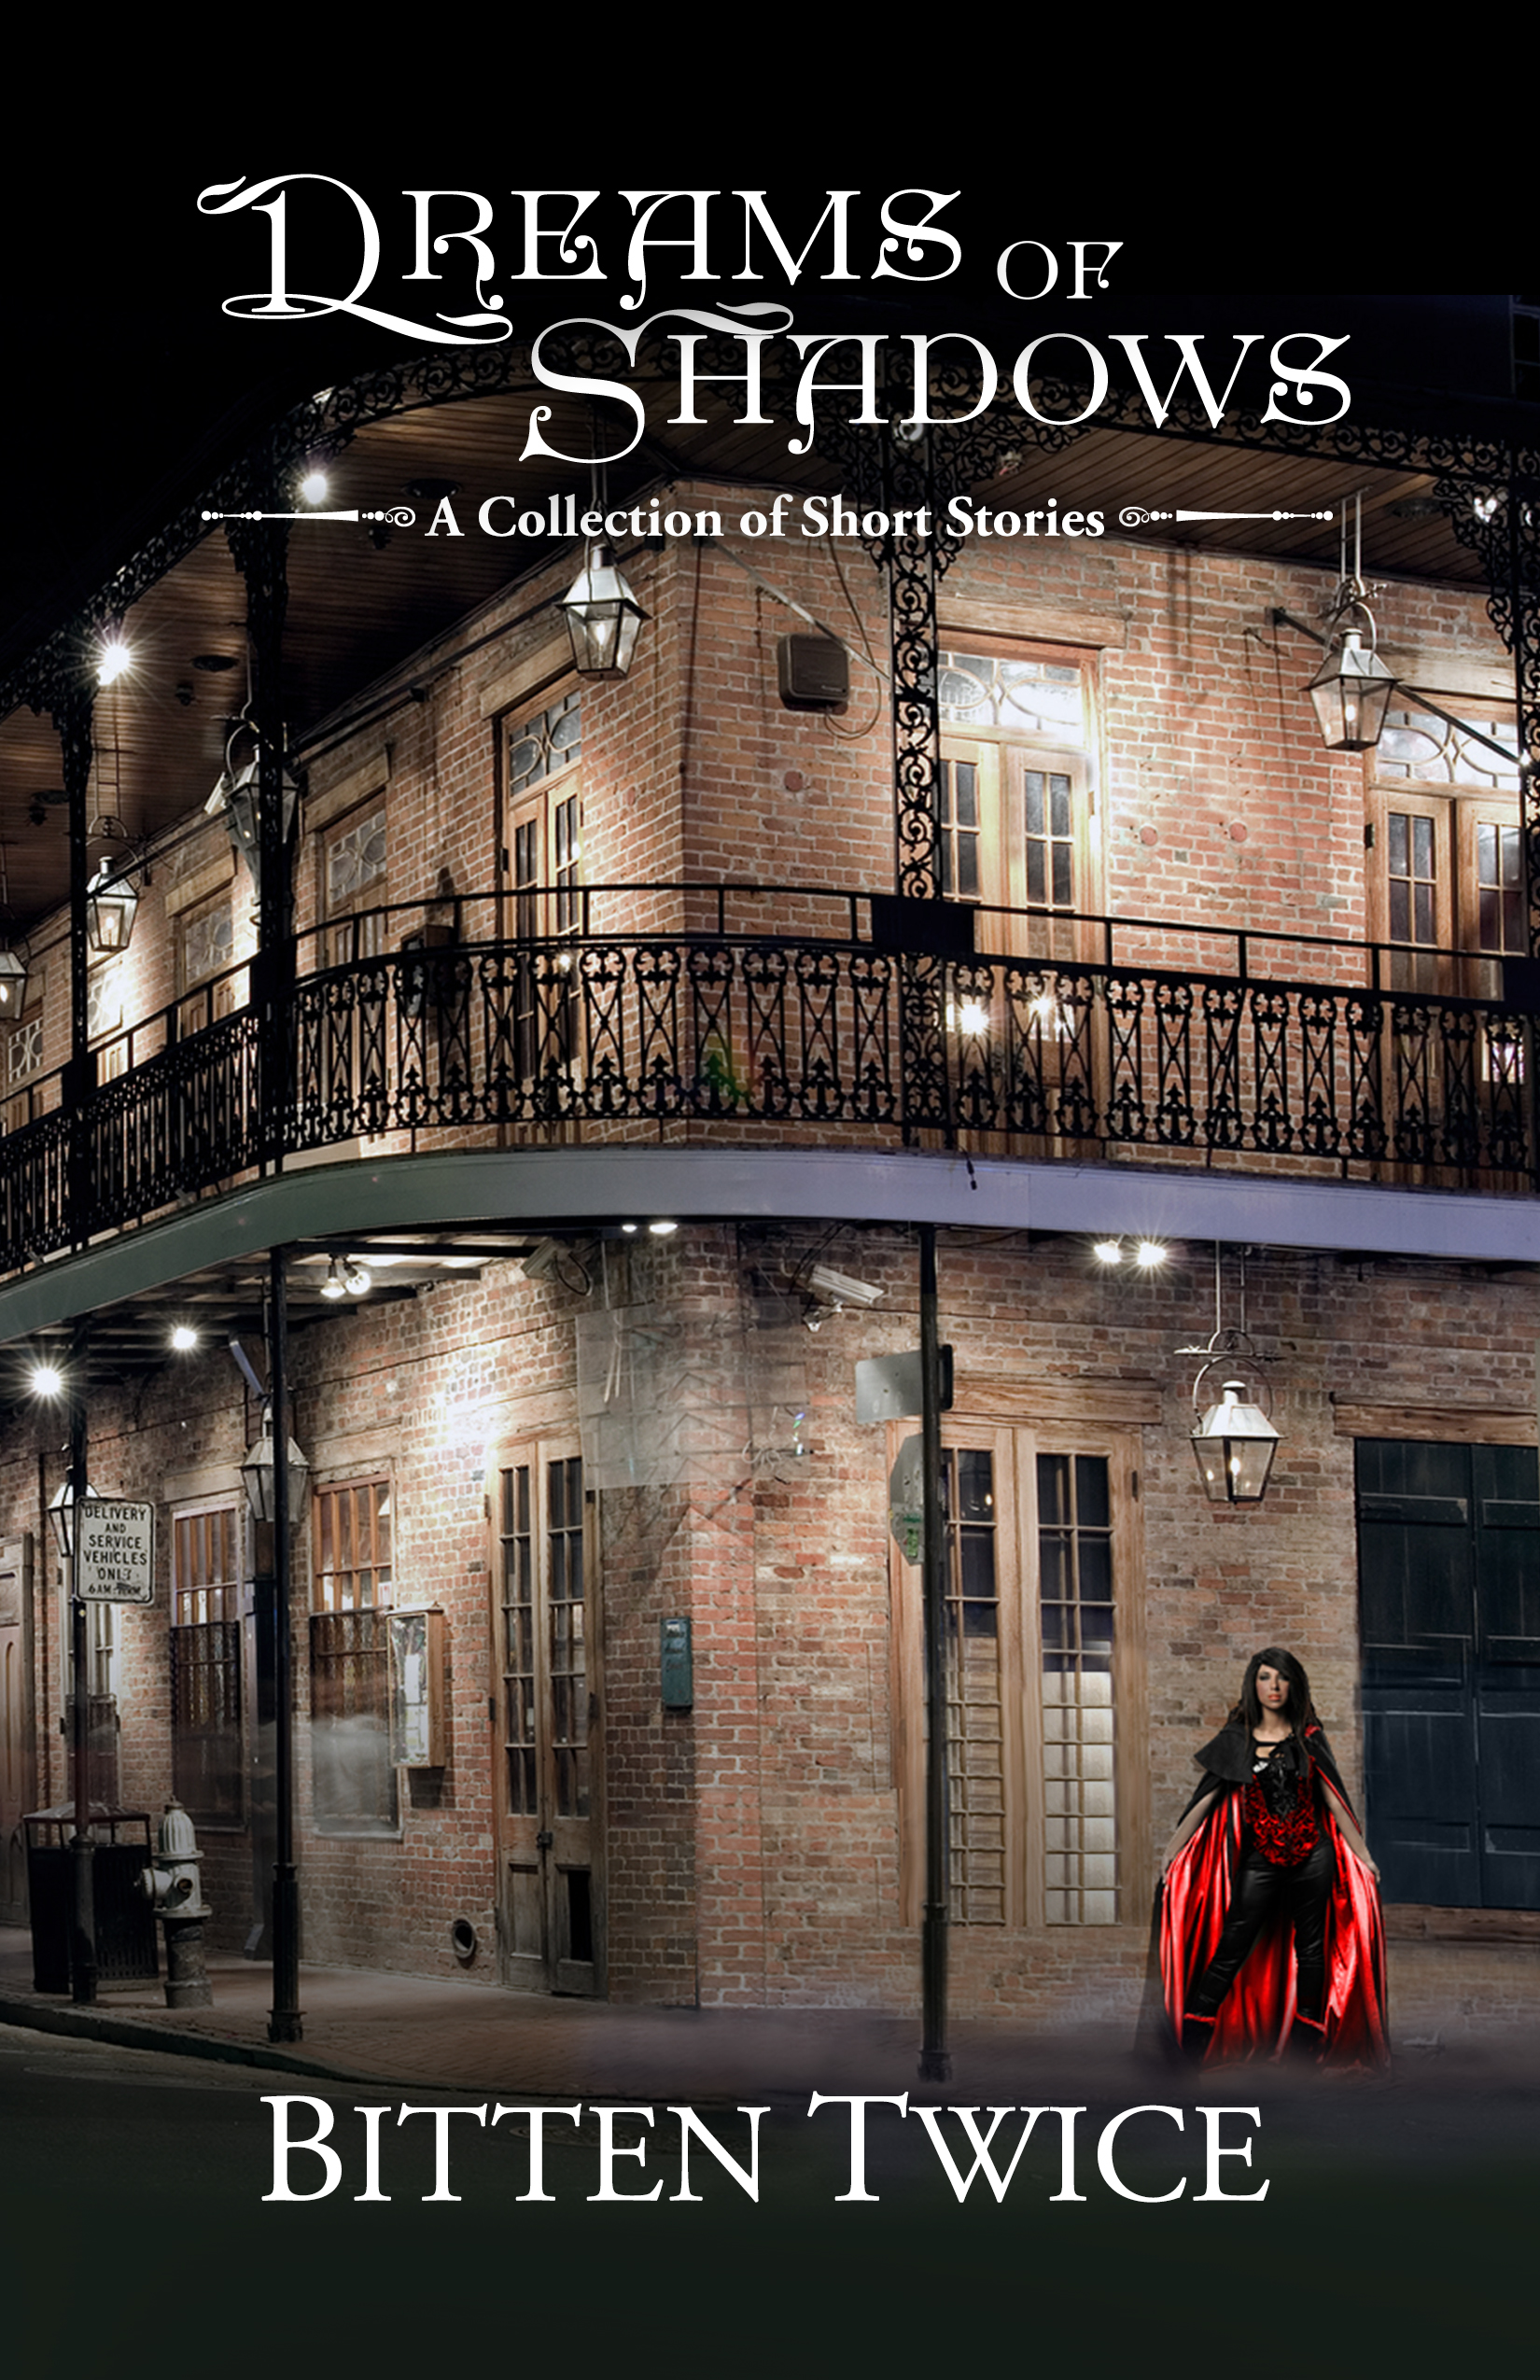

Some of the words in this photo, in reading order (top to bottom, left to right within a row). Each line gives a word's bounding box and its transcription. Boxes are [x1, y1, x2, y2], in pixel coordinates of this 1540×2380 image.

[85, 1505, 147, 1521] DELIVERY
[105, 1522, 127, 1533] AND
[89, 1534, 142, 1549] SERVICE
[83, 1549, 147, 1565] VEHICLES
